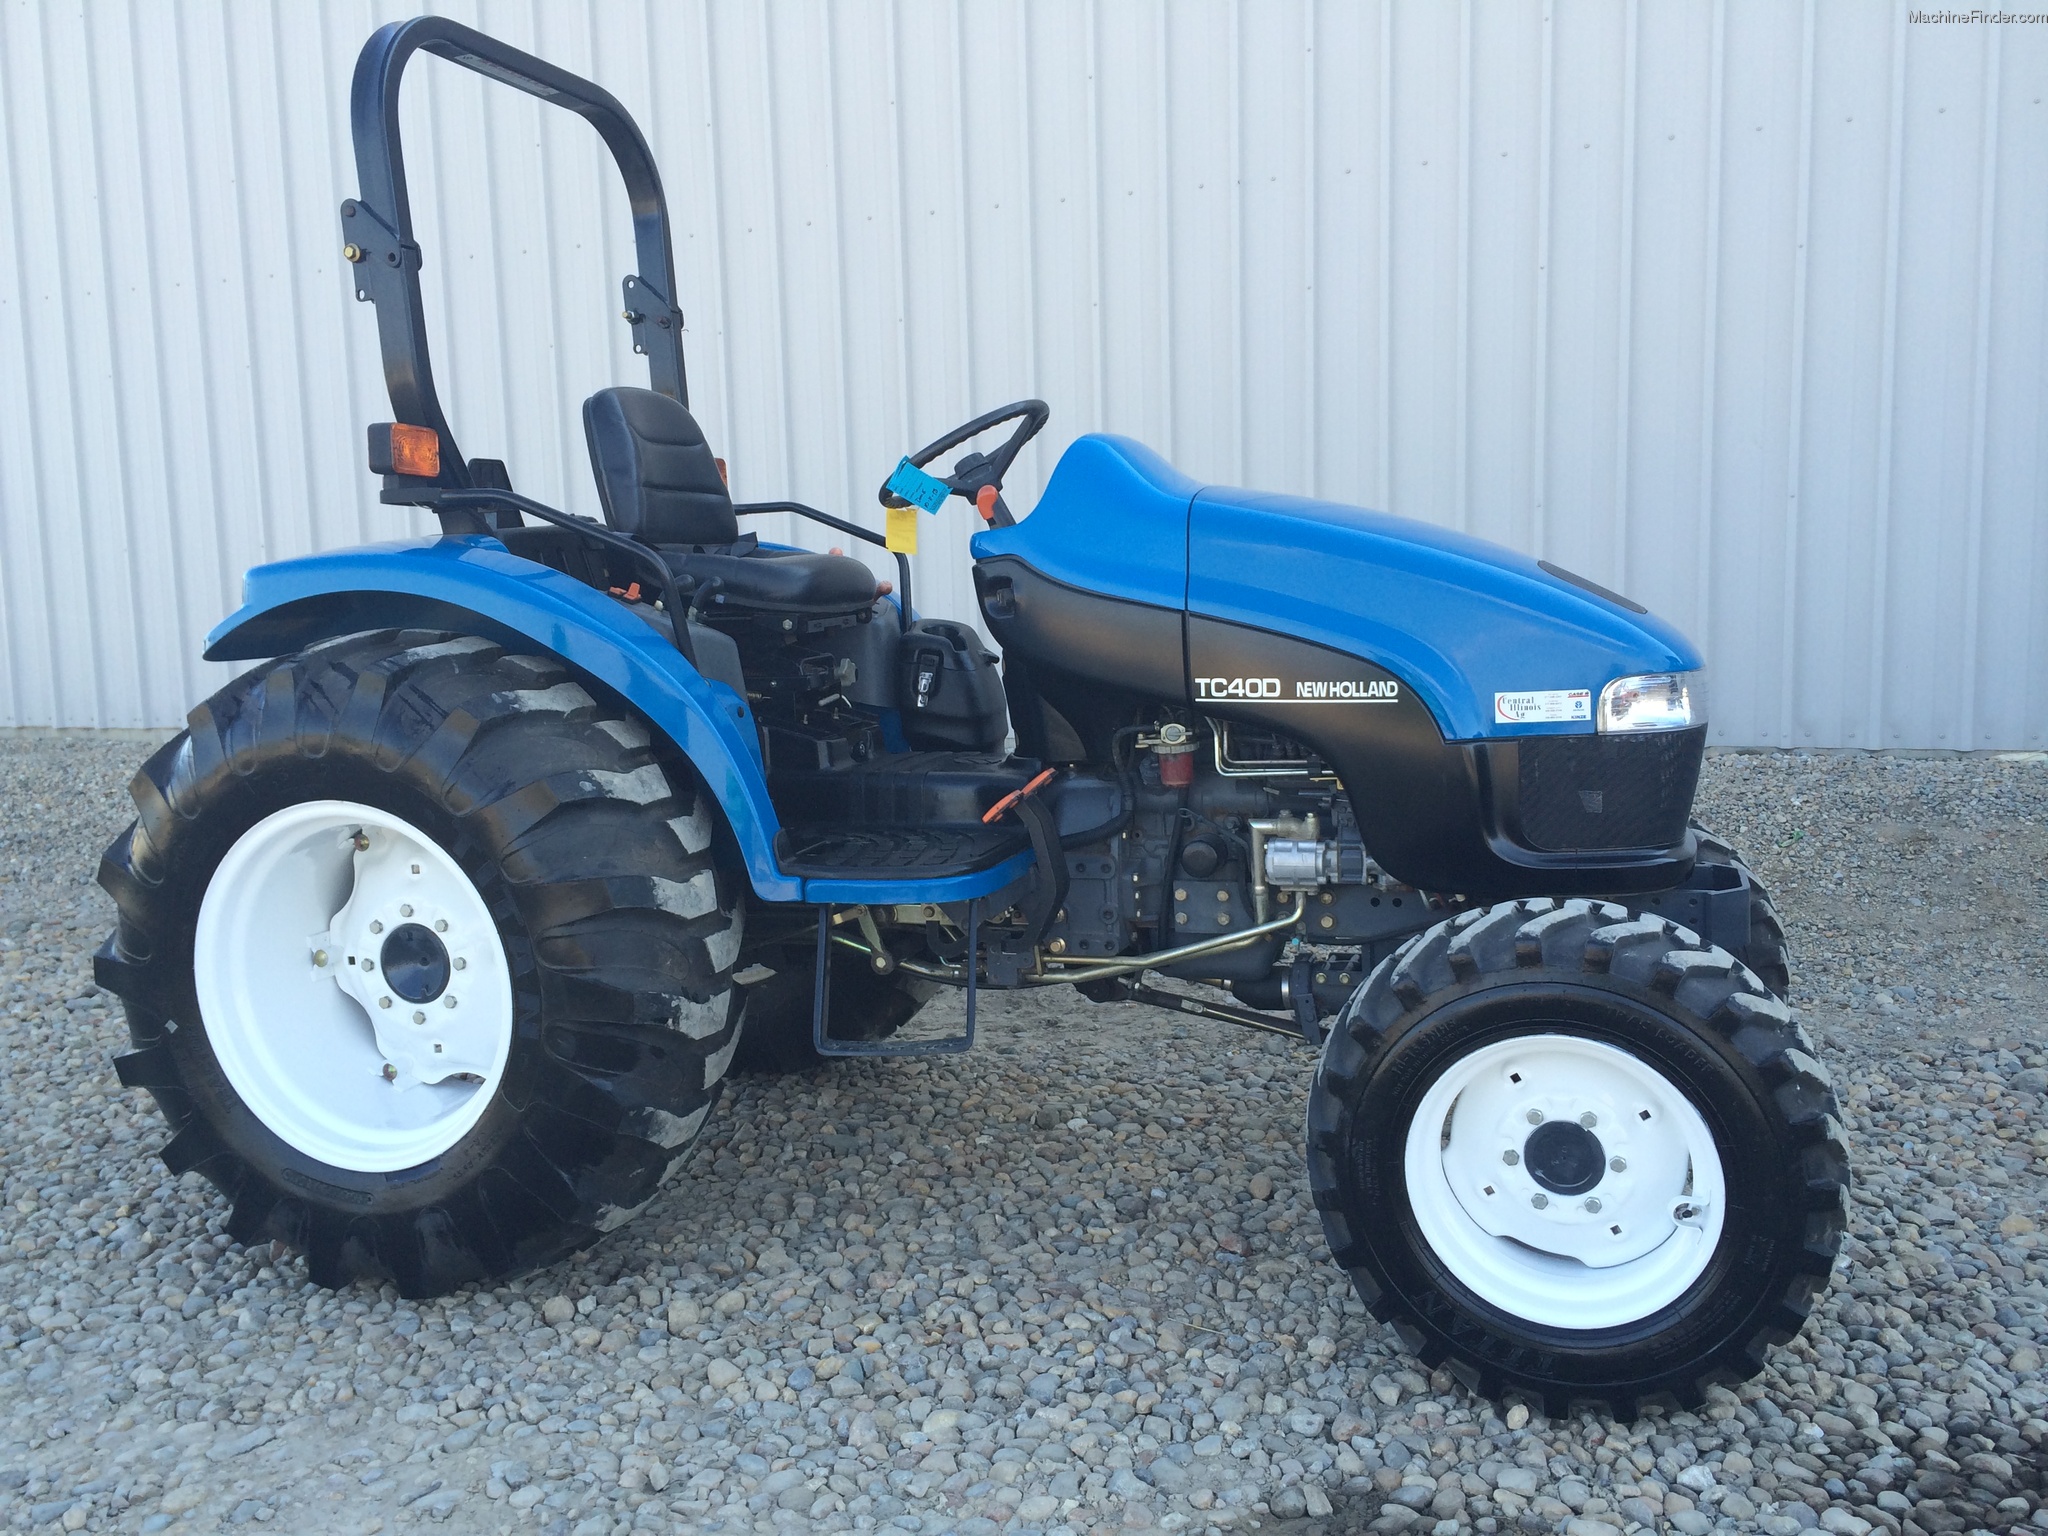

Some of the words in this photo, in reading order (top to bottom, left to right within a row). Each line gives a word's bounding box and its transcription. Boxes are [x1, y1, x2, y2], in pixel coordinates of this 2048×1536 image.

[1195, 677, 1281, 698] TC40D
[1296, 681, 1328, 698] NEW
[1329, 680, 1399, 698] HOLLAND
[1502, 696, 1535, 704] Central
[1510, 703, 1542, 711] Illinois
